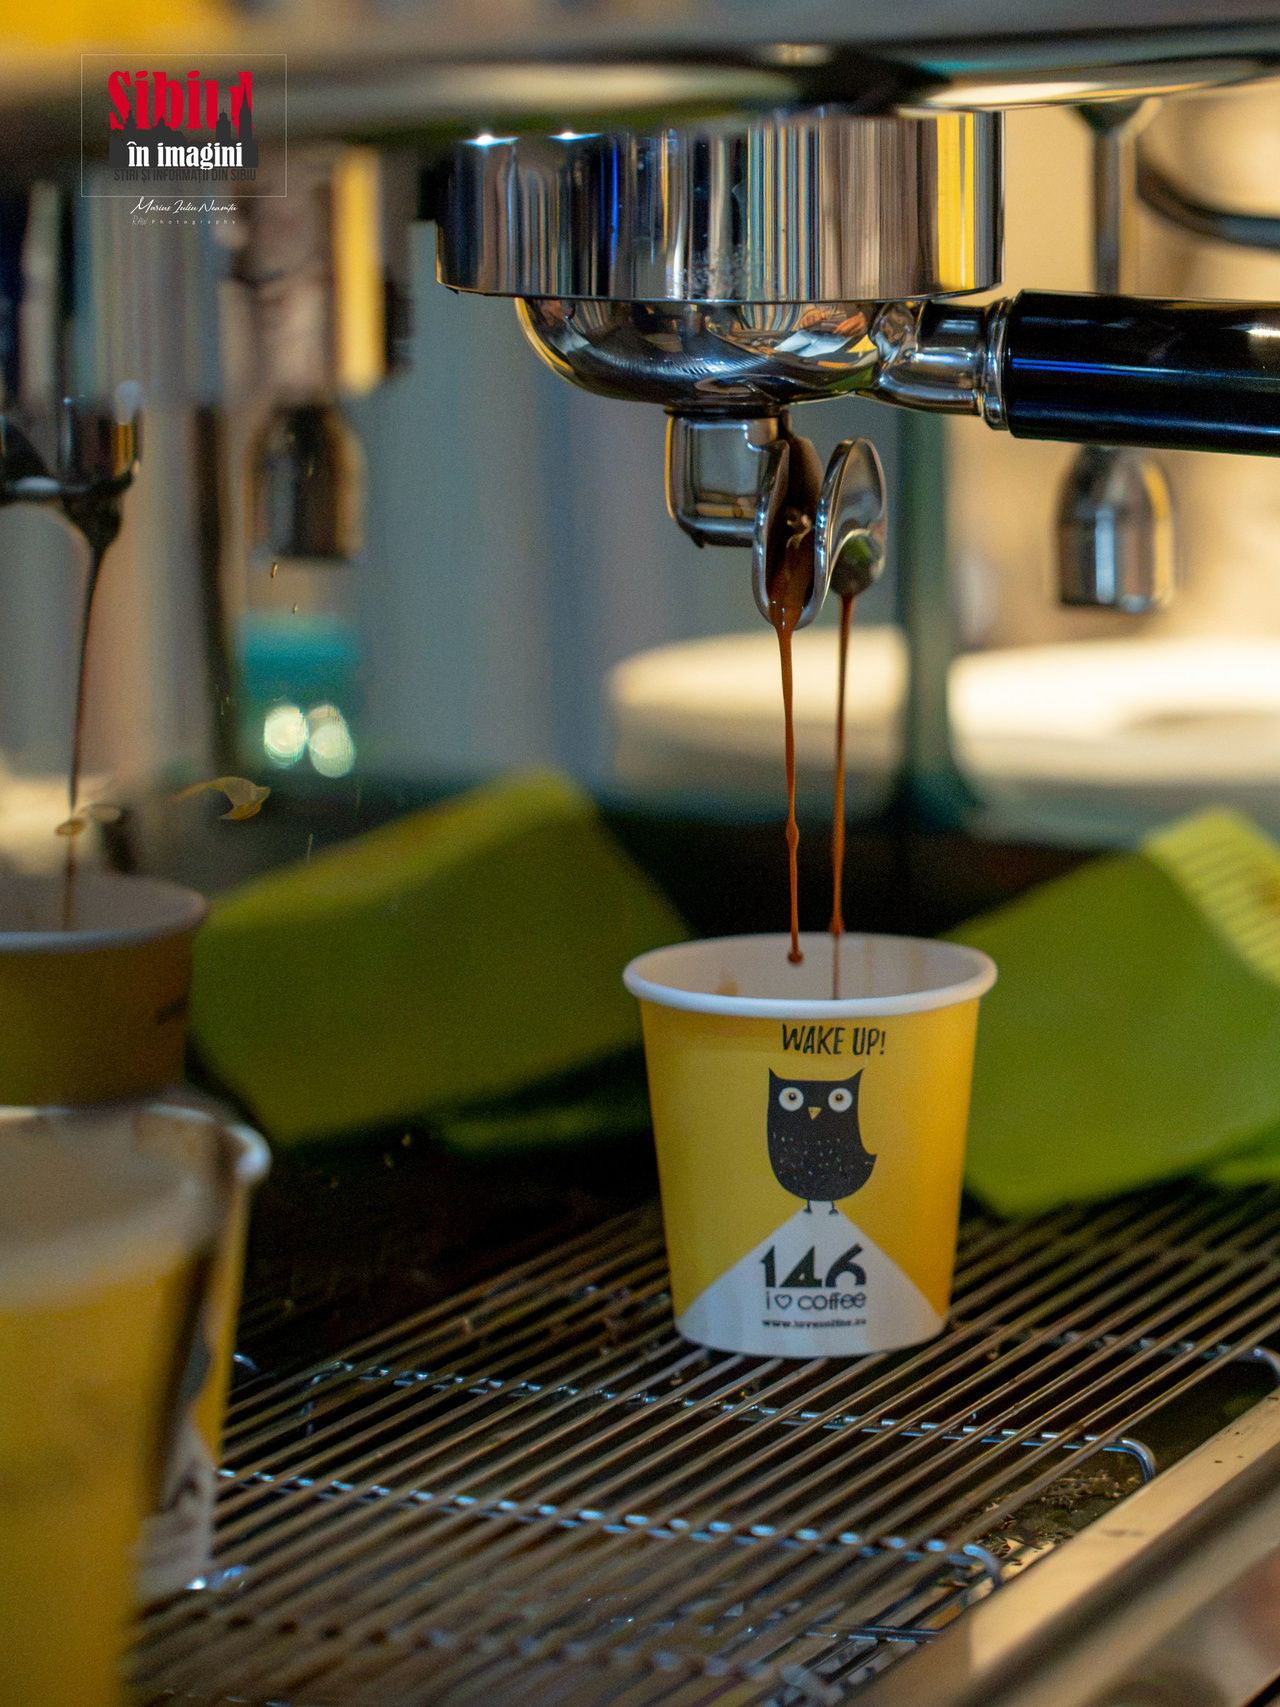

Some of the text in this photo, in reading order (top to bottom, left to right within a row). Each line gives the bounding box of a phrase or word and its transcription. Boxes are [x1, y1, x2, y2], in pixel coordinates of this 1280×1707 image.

[782, 1023, 886, 1055] WAKE UP!
[760, 1243, 866, 1288] 146
[798, 1291, 866, 1310] coffee
